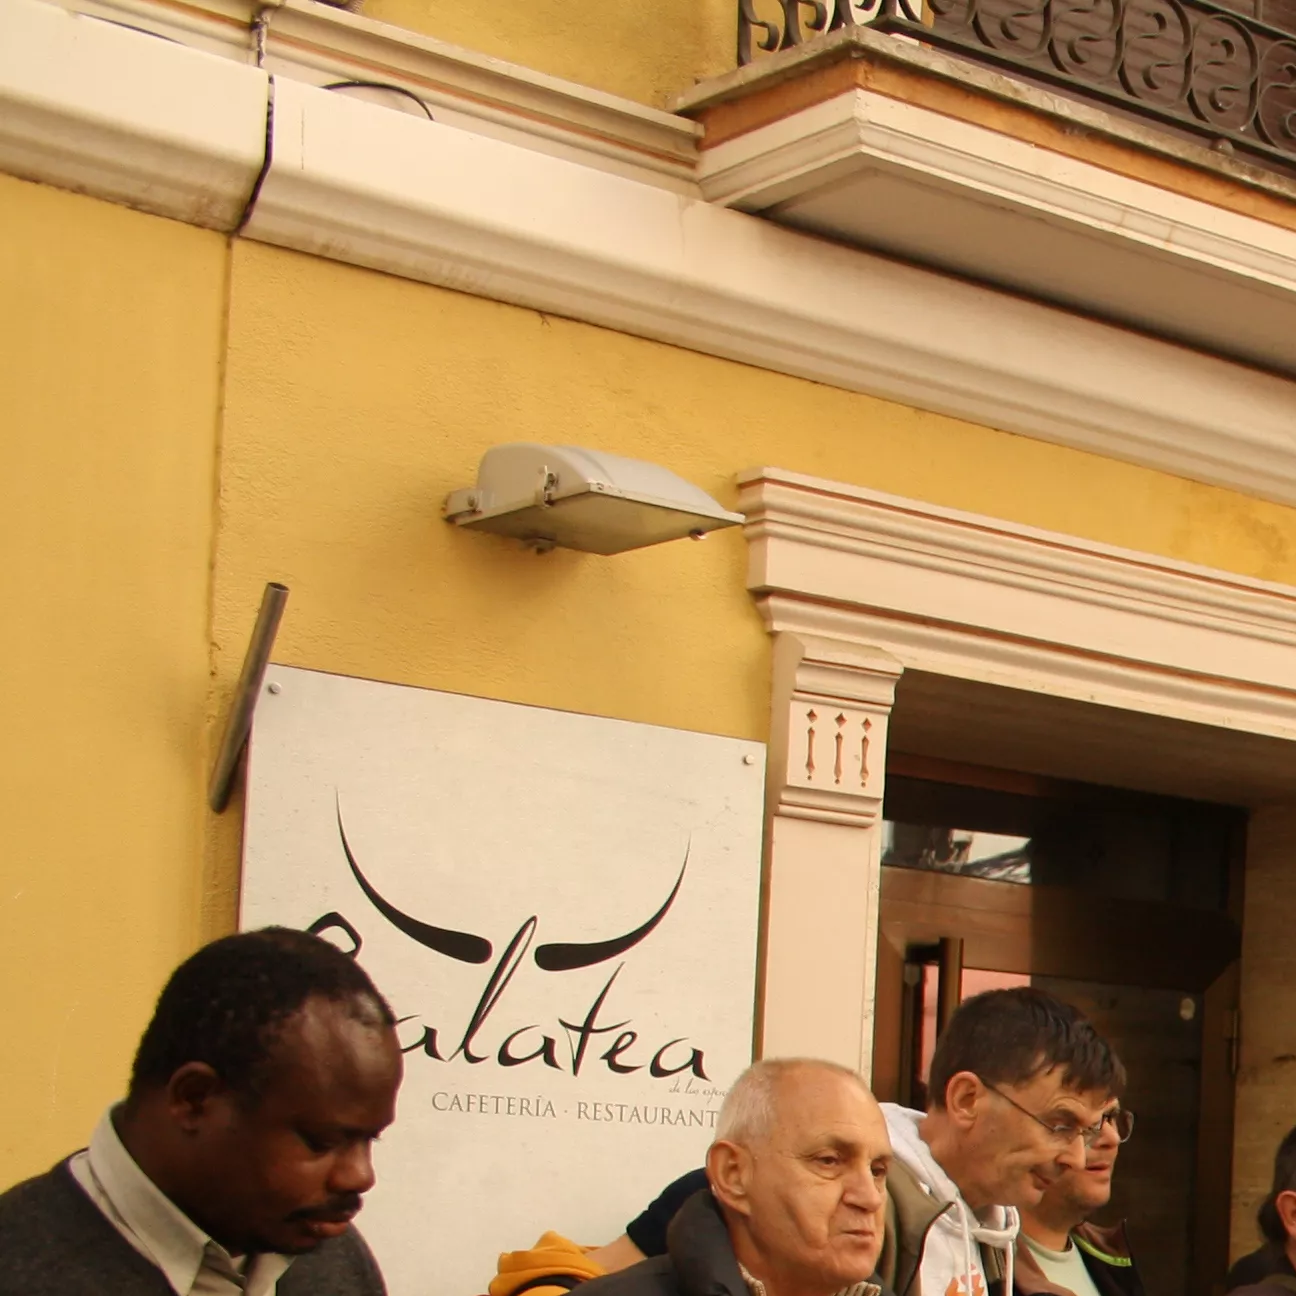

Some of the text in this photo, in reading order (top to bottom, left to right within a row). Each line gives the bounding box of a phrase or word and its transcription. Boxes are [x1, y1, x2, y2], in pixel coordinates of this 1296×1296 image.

[308, 910, 713, 1082] alatea
[431, 1091, 719, 1129] CAFETERÍA RESTAURANT
